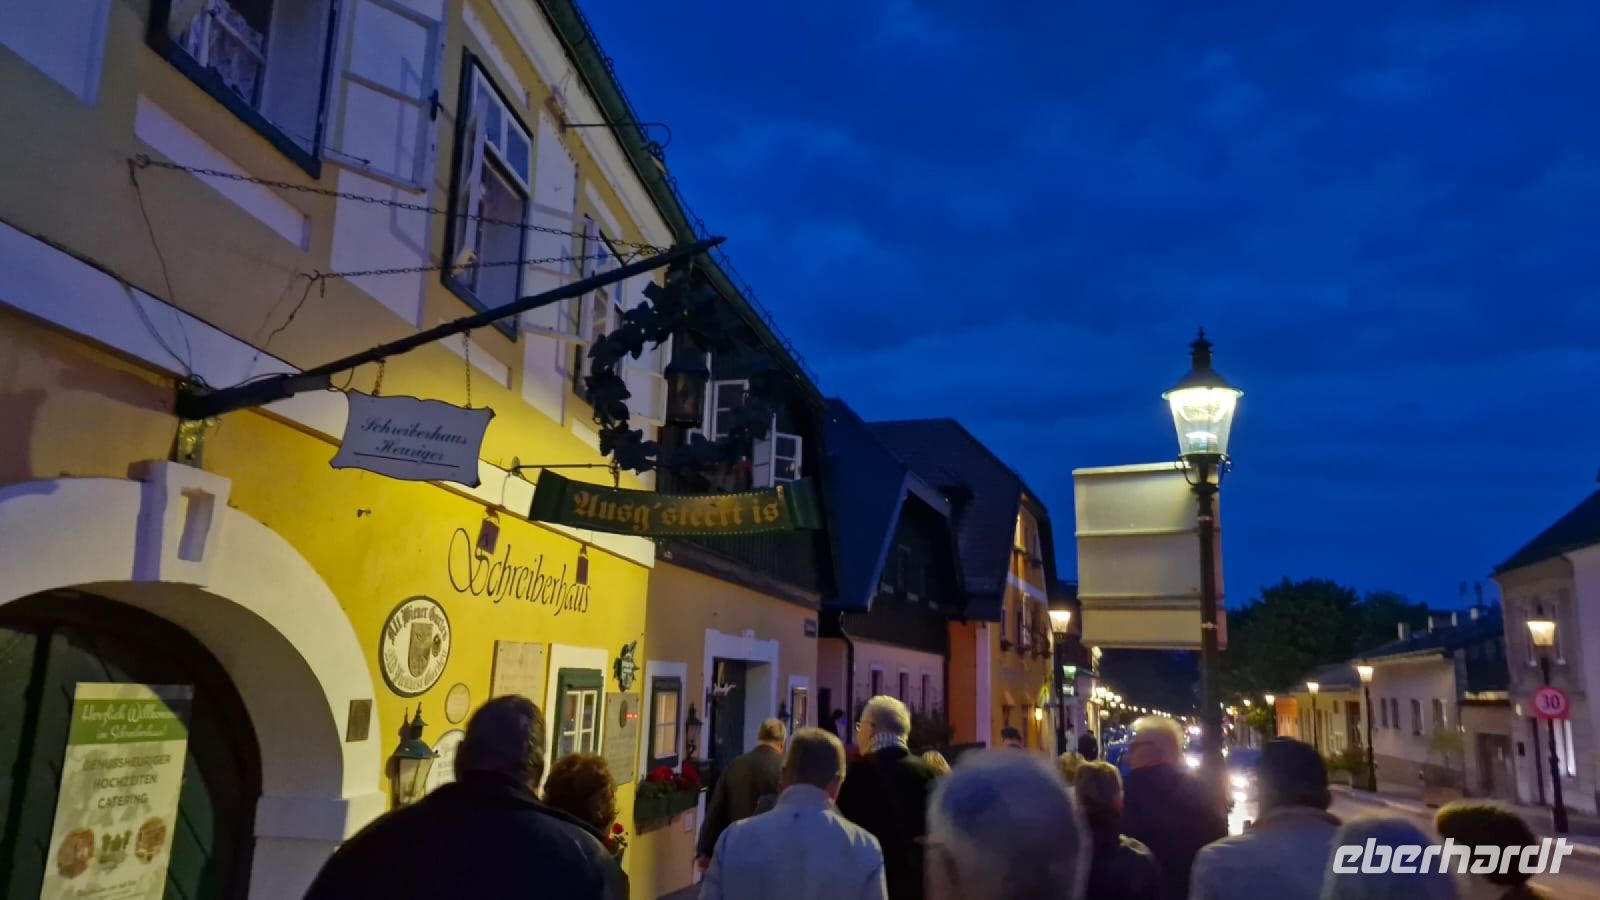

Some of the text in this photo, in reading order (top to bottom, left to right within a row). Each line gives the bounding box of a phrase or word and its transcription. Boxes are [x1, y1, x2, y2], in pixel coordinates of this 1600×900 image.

[360, 418, 467, 445] Schreiberhaus
[376, 439, 444, 463] Heuriger
[752, 499, 780, 524] is
[448, 527, 592, 616] Schreiberhaus
[1541, 694, 1561, 710] 30
[93, 773, 157, 790] HOCHZEITEN
[97, 793, 149, 809] CATERING
